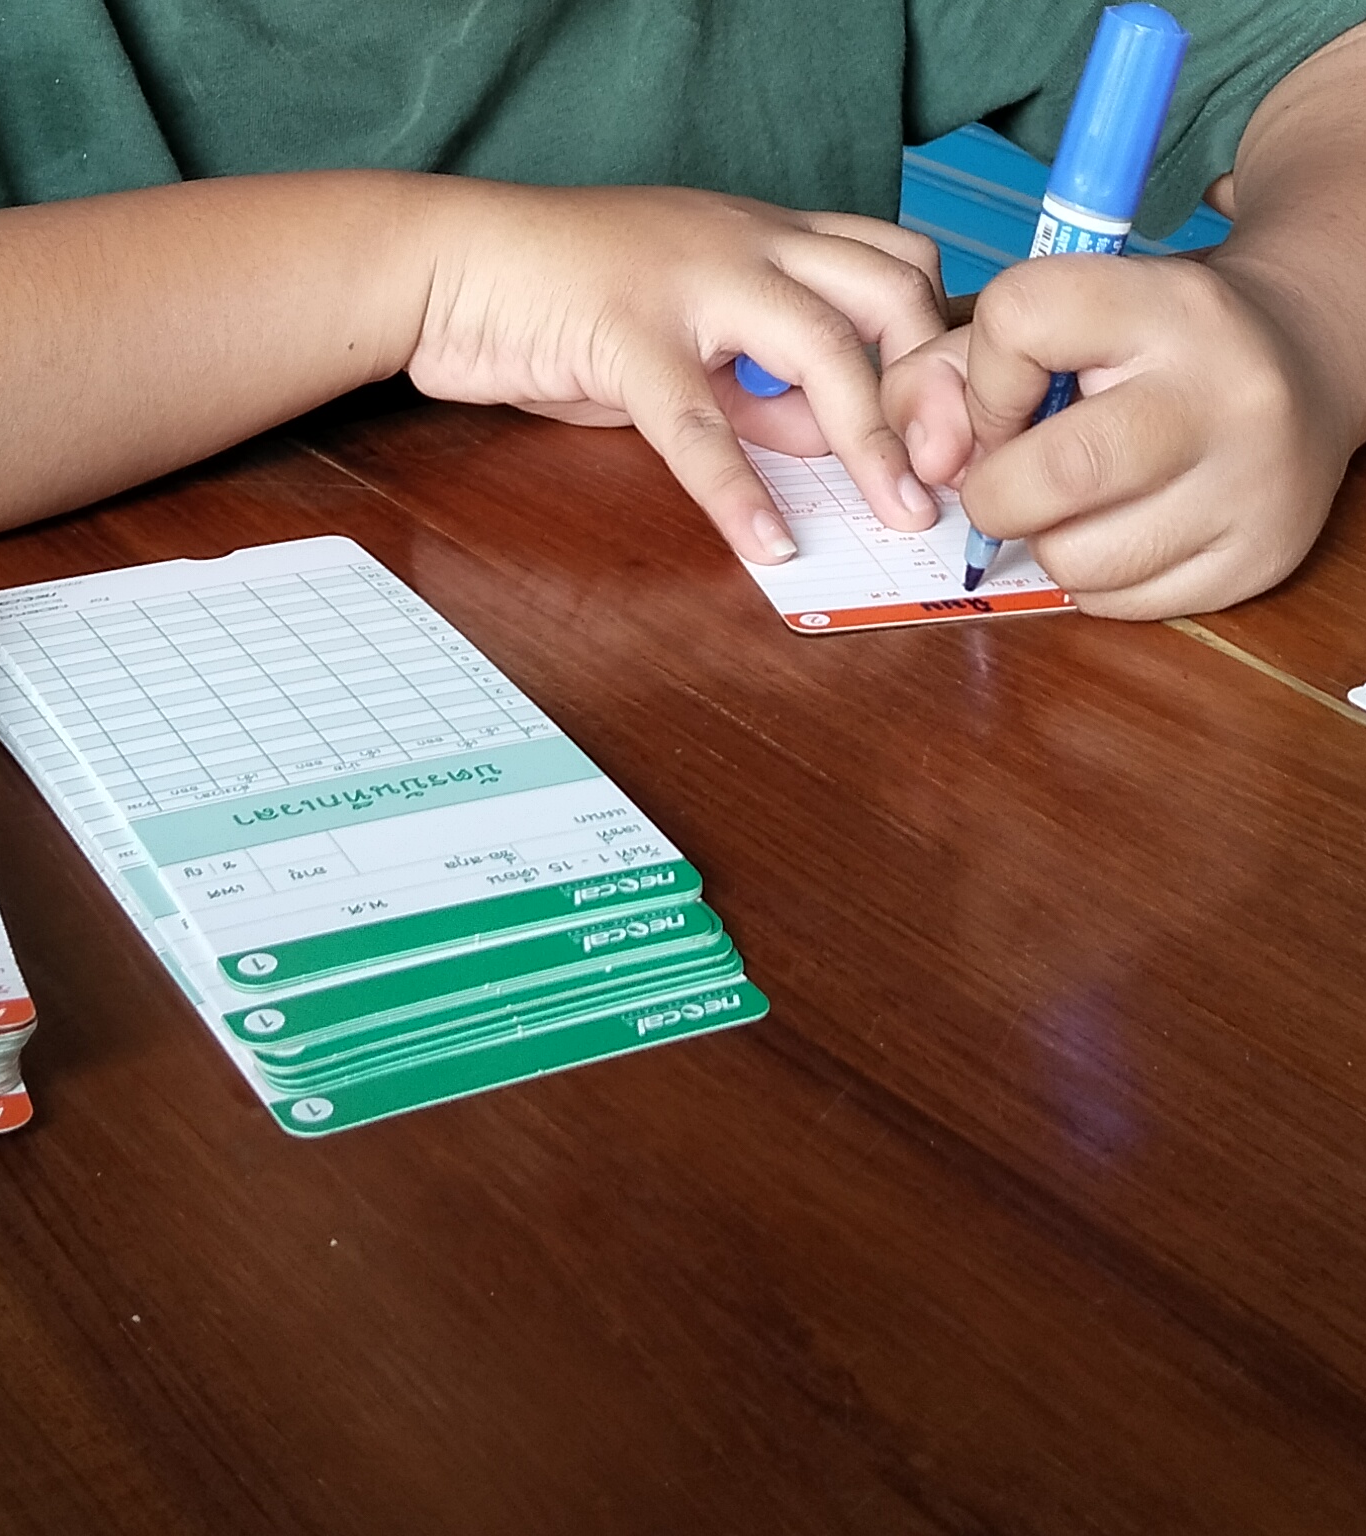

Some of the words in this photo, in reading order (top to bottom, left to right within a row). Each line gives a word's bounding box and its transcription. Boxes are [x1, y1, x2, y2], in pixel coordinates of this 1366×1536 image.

[231, 762, 503, 828] บัตรบันทึกเวลา
[572, 807, 628, 825] แผนก
[614, 843, 662, 866] วันที่
[287, 865, 328, 881] อายุ
[486, 866, 540, 885] เดือน
[548, 860, 573, 874] 15
[206, 883, 245, 900] เพศ
[573, 870, 676, 906] neocal
[340, 899, 388, 916] พ.ศ.
[583, 912, 686, 953] neocal
[250, 956, 267, 971] 1
[256, 1013, 275, 1028] 1
[637, 993, 741, 1037] neocal
[304, 1102, 322, 1117] 1
